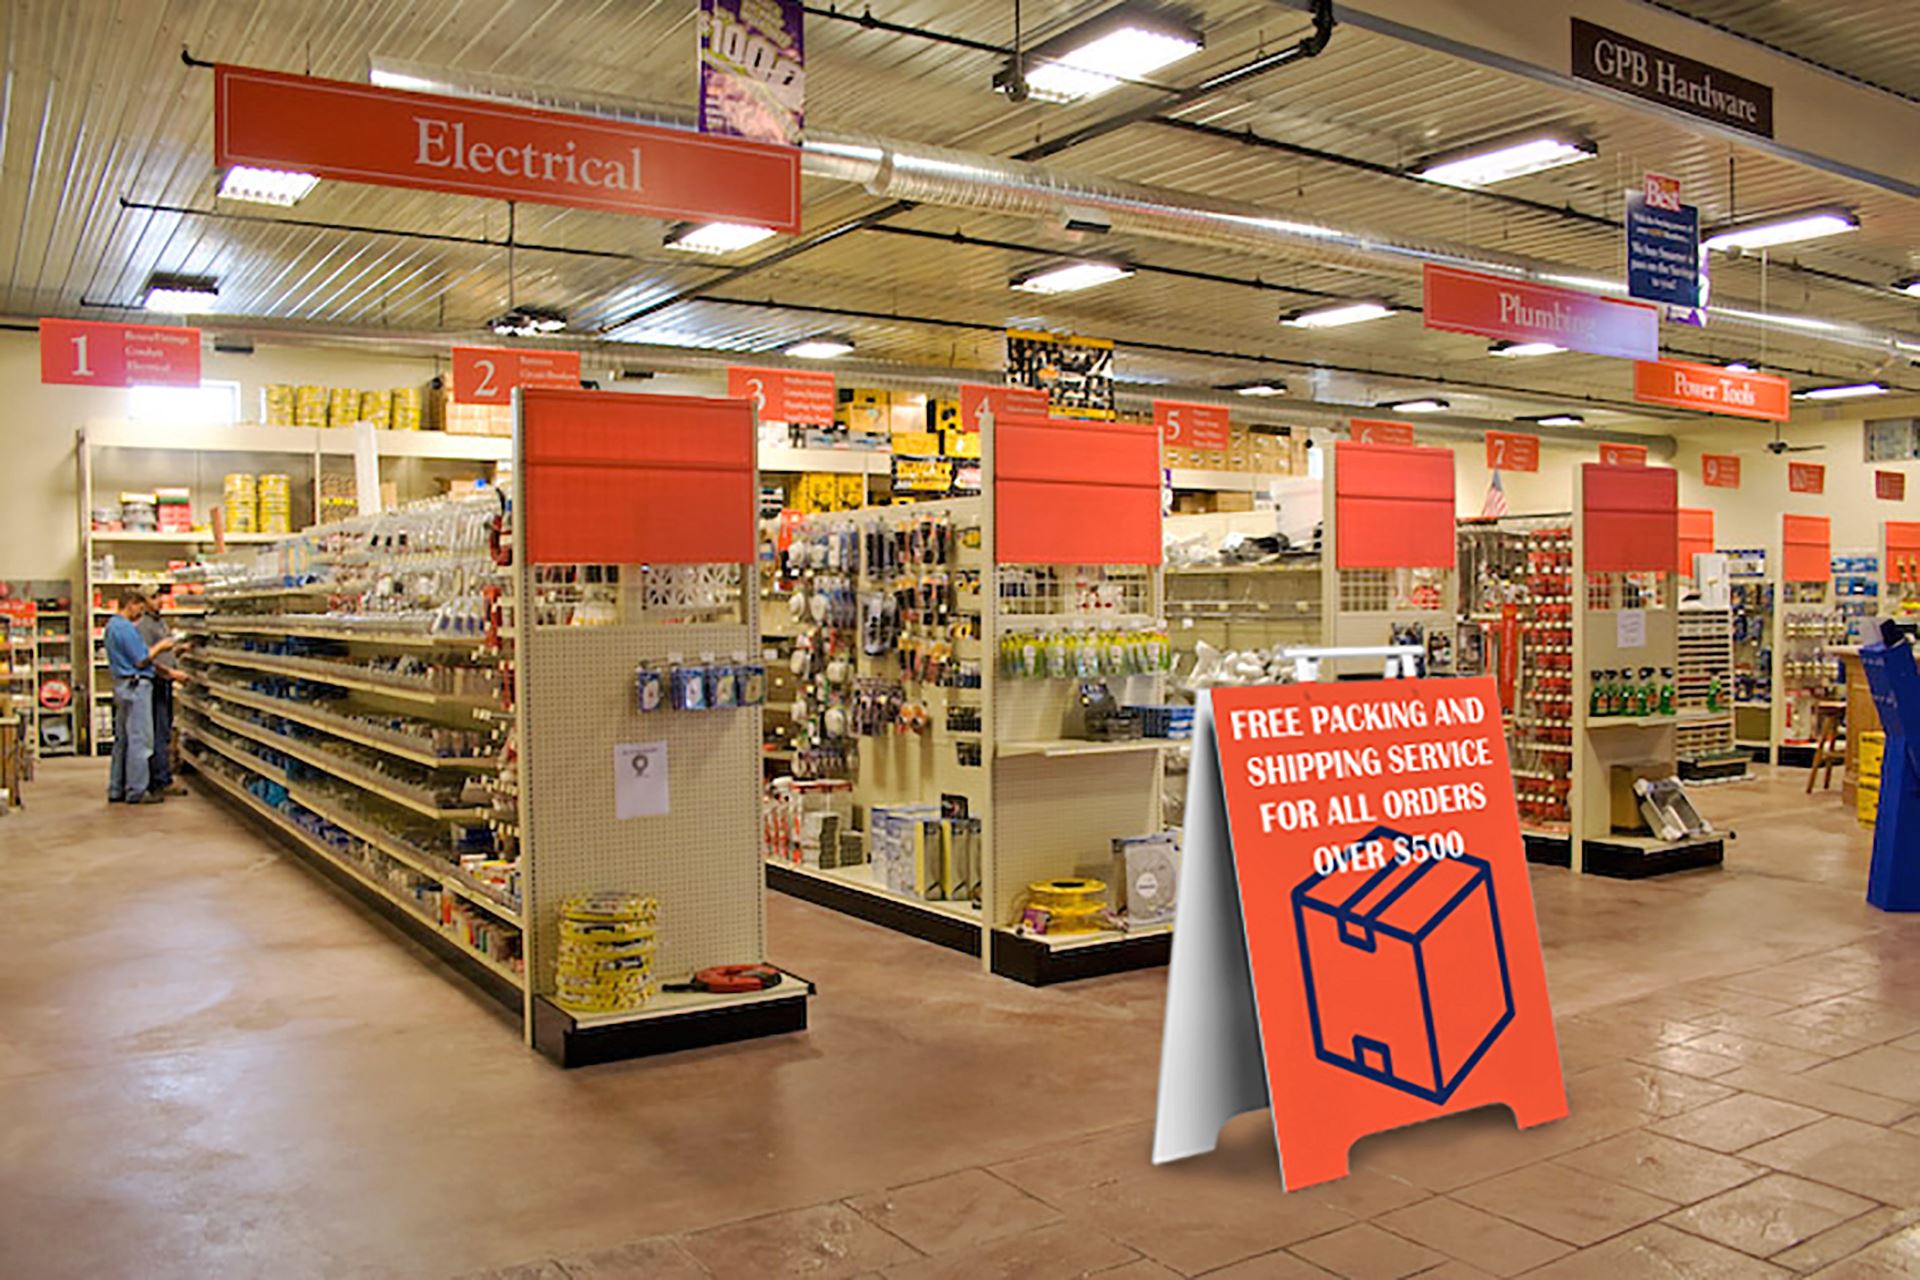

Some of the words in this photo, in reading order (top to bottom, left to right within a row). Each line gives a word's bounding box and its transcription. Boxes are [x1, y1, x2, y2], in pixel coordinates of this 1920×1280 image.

[1594, 39, 1649, 87] GPB
[1655, 59, 1758, 123] Hardware
[412, 116, 645, 193] Electrical
[1498, 292, 1598, 343] Plumbing
[70, 334, 95, 376] 1
[473, 359, 498, 397] 2
[746, 378, 766, 411] 3
[1674, 371, 1718, 400] Power
[1719, 379, 1756, 406] Tools
[1167, 409, 1181, 441] 5
[1494, 439, 1506, 465] 7
[1707, 458, 1718, 482] 9
[1230, 706, 1304, 741] FREE
[1309, 700, 1428, 735] PACKING
[1434, 696, 1485, 726] AND
[1247, 747, 1382, 787] SHIPPING
[1387, 738, 1493, 774] SERVICE
[1259, 800, 1319, 833] FOR
[1327, 793, 1377, 826] ALL
[1382, 782, 1488, 819] ORDERS
[1313, 840, 1387, 877] OVER
[1393, 829, 1465, 867] $500
